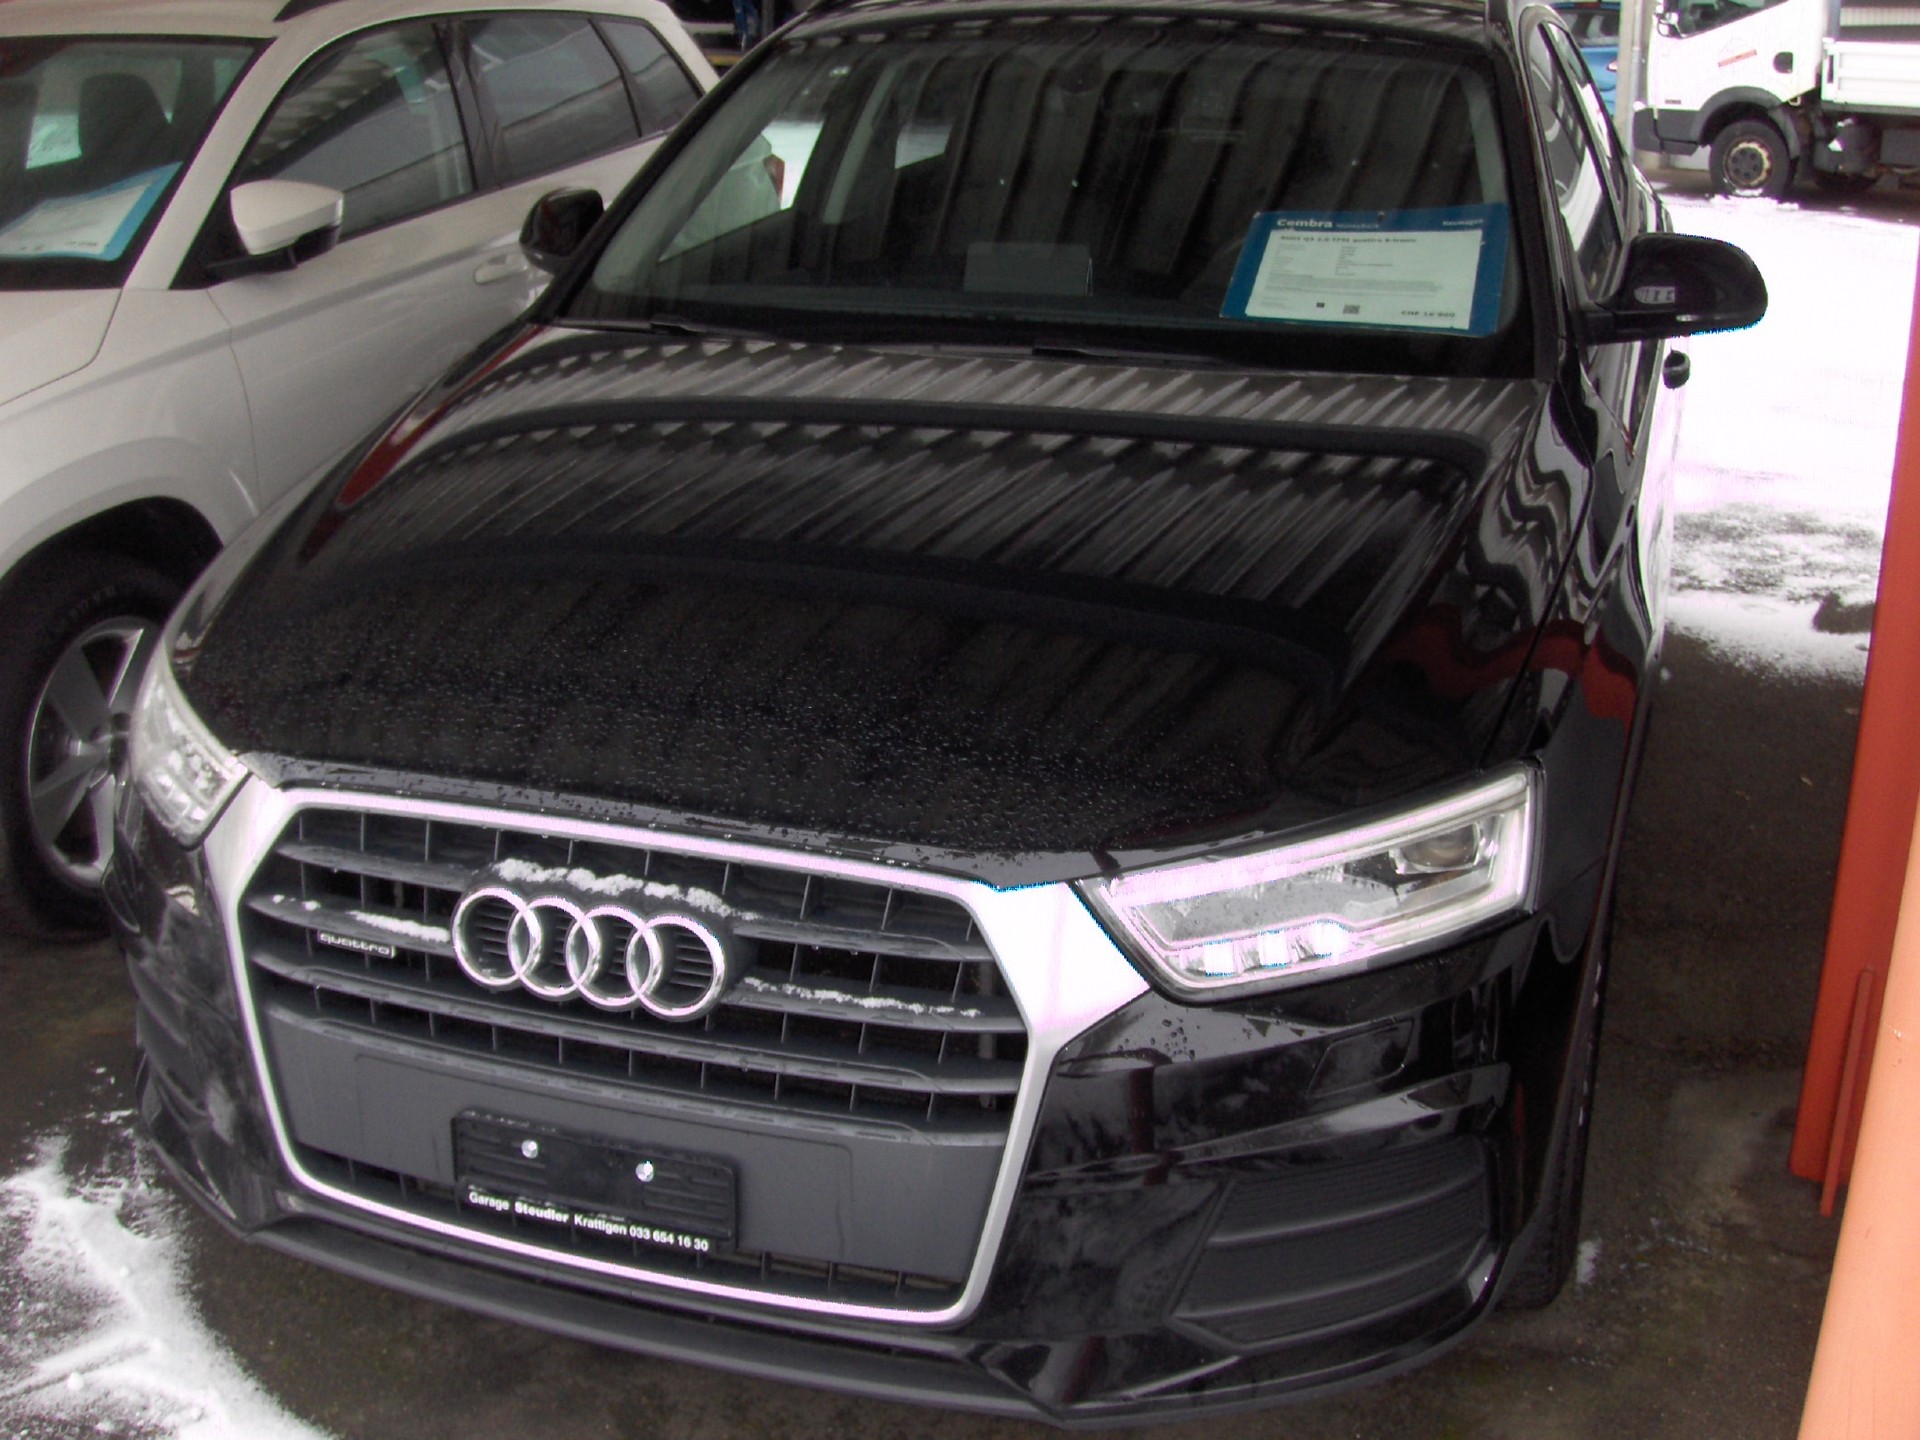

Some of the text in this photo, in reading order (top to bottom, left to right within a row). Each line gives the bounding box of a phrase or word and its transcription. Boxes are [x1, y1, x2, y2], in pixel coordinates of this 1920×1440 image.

[1277, 218, 1333, 229] Cembra
[320, 933, 390, 955] quattro
[468, 1191, 709, 1252] Garage Steudler Krattigen 033 654 16 30
